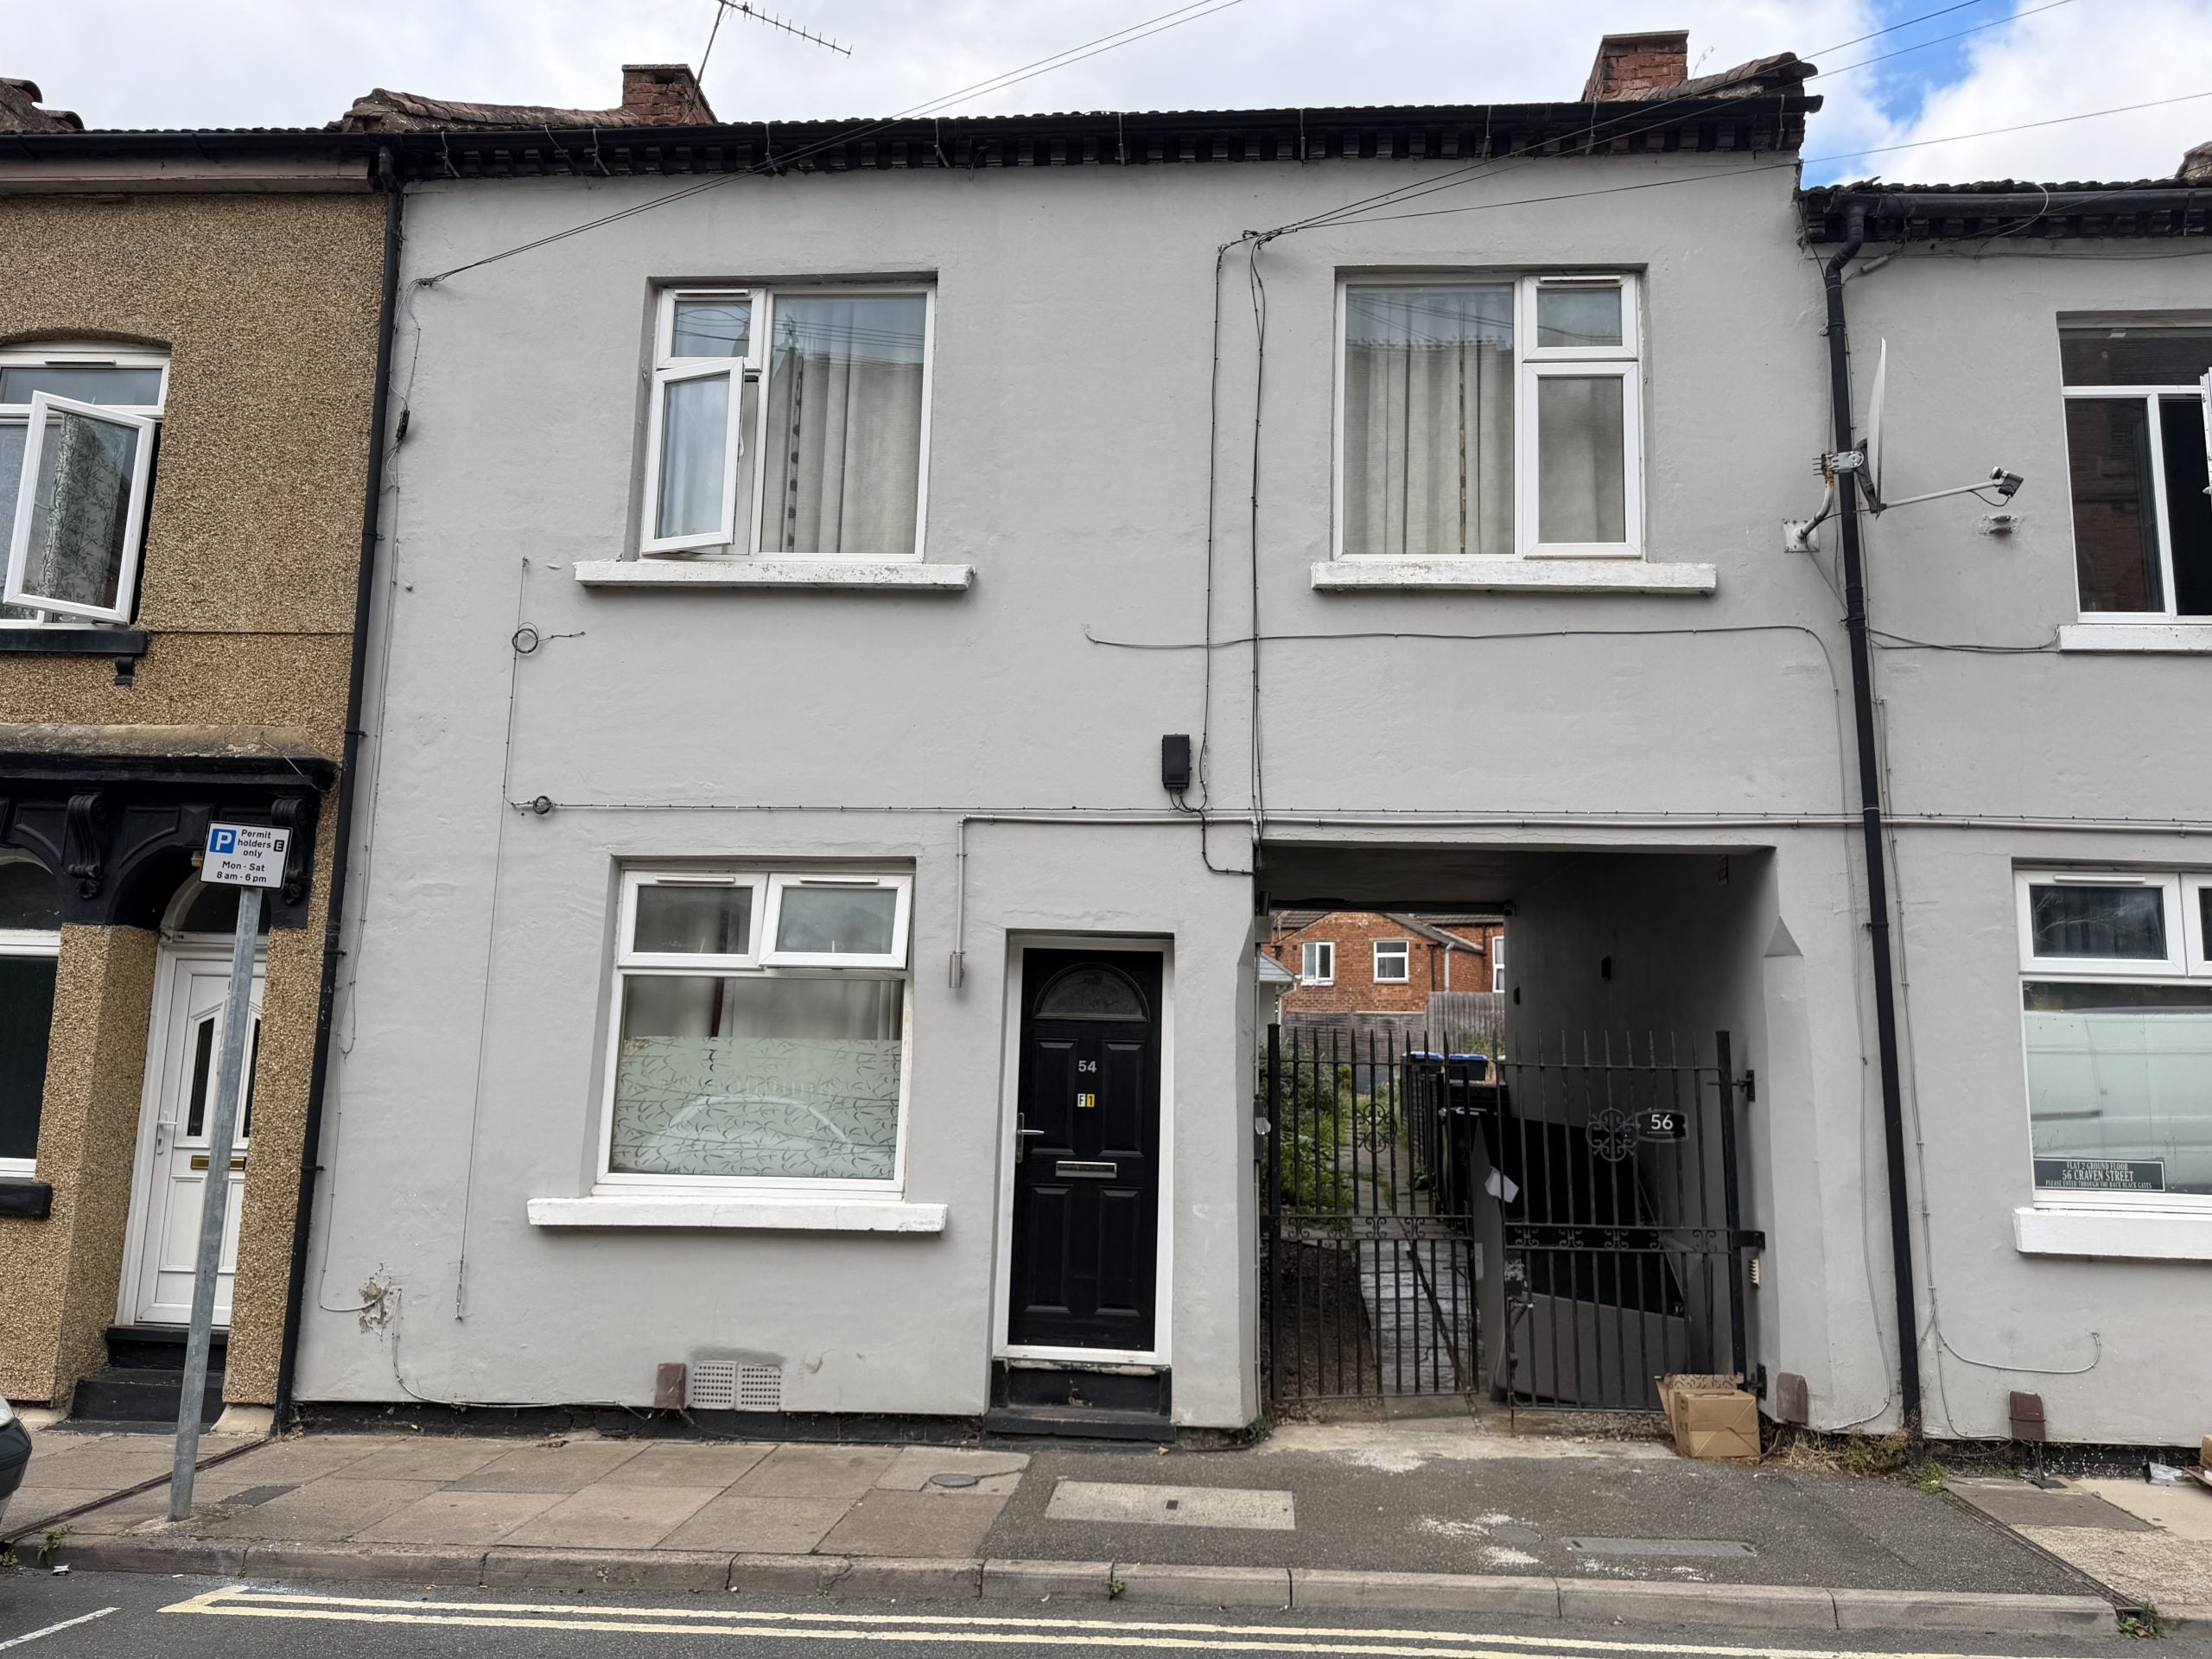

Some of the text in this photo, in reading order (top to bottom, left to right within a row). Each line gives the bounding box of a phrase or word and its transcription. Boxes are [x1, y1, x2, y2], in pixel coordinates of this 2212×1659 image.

[241, 830, 271, 839] Permit
[215, 831, 232, 851] P
[238, 838, 271, 849] holders
[276, 841, 283, 851] E
[243, 849, 263, 859] only
[222, 861, 242, 869] Mon
[249, 863, 265, 872] Sat
[1077, 1059, 1097, 1073] 54
[1078, 1094, 1094, 1106] F1
[1650, 1114, 1674, 1130] 56
[2066, 1161, 2129, 1171] FLAT 2 GROUND FLOOR
[2062, 1169, 2134, 1182] 56 CRAVEN STREET
